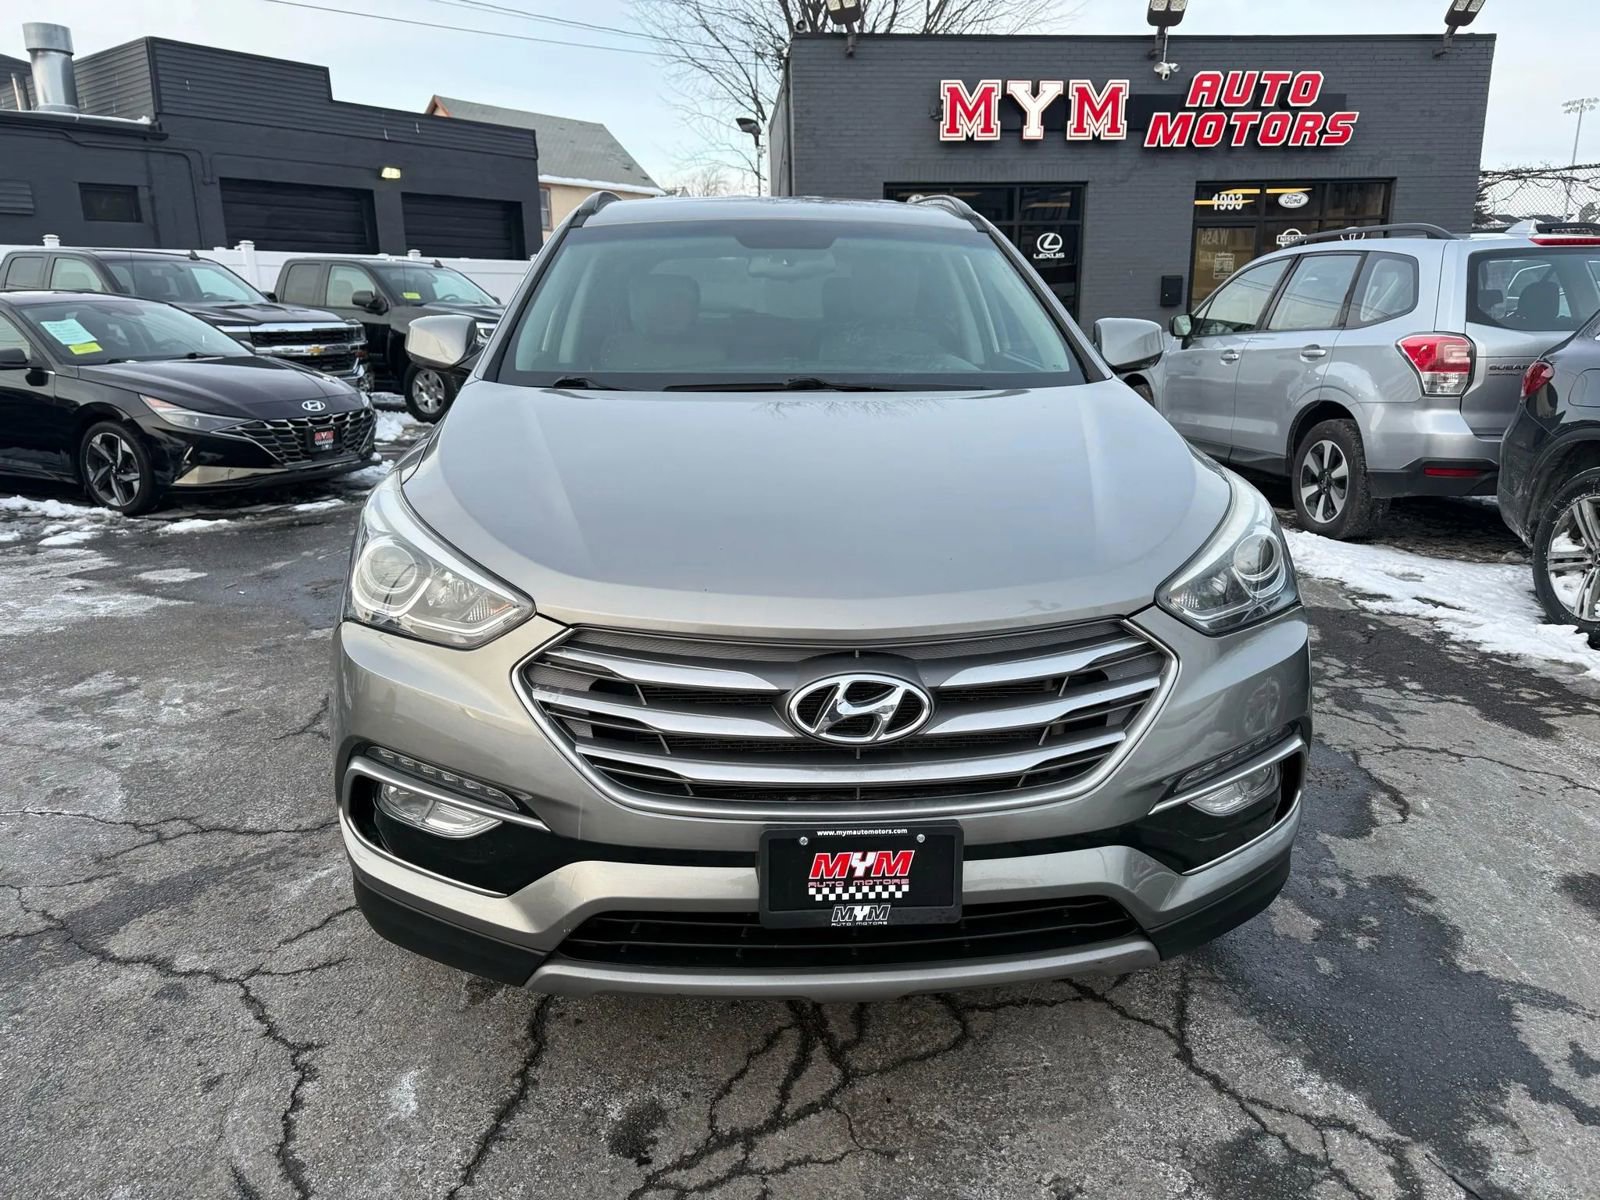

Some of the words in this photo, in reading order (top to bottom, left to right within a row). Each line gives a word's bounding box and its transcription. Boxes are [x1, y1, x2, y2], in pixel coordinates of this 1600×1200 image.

[1185, 70, 1325, 108] AUTO
[940, 79, 1130, 142] MYM
[1143, 111, 1360, 148] MOTORS
[1212, 193, 1243, 210] 1993
[816, 829, 908, 837] www.mymautomotors.com
[809, 850, 915, 879] MYM
[831, 904, 891, 922] MYM
